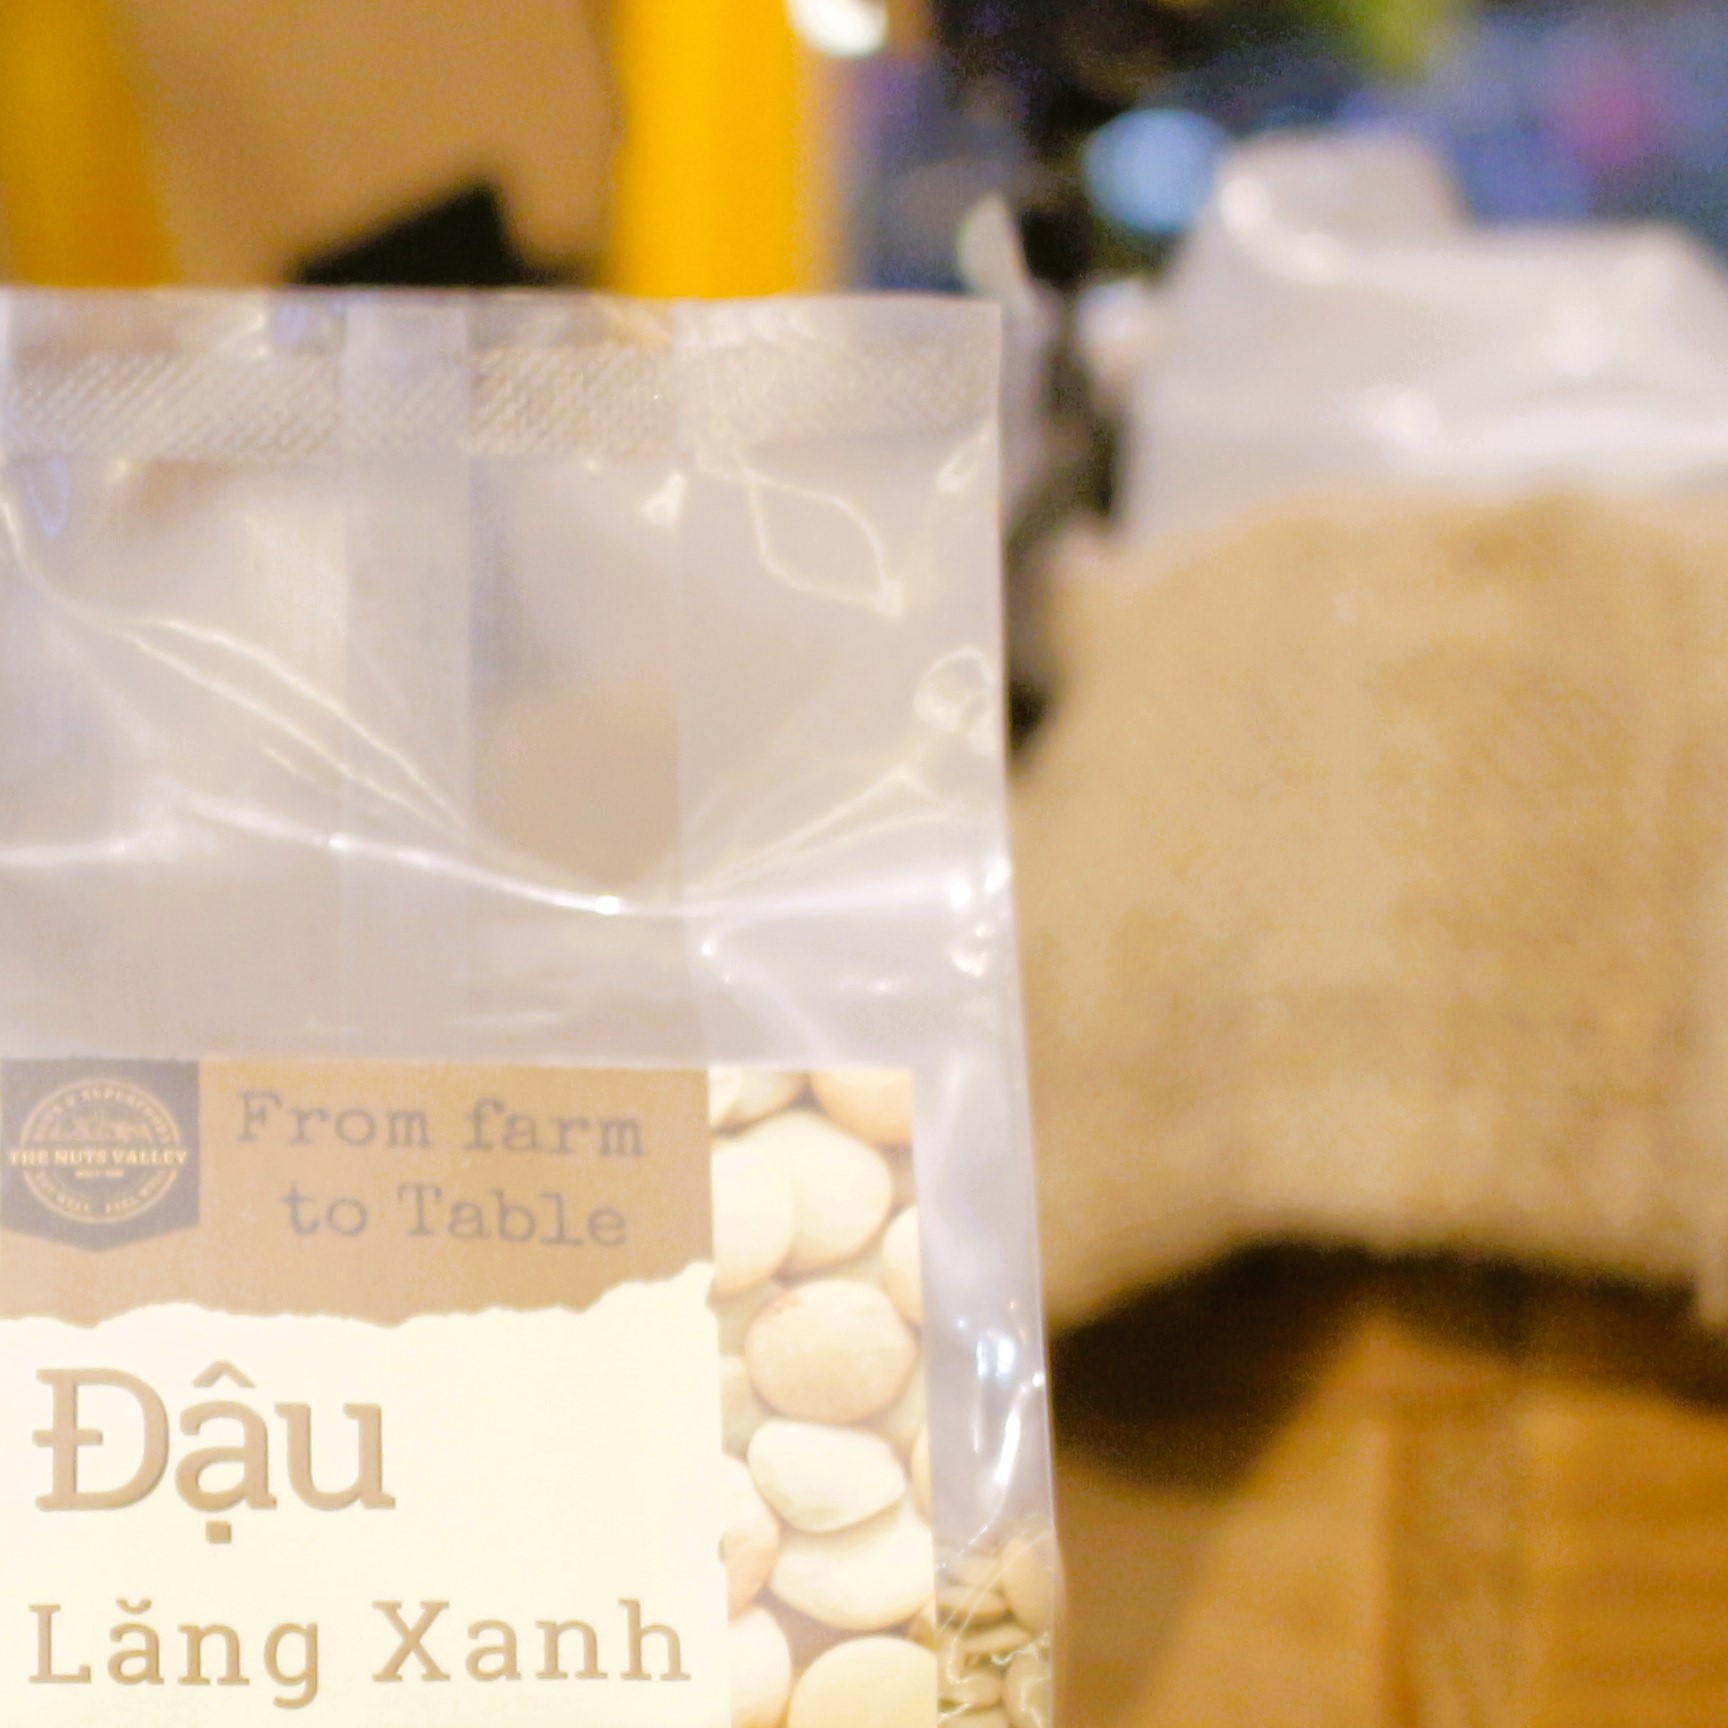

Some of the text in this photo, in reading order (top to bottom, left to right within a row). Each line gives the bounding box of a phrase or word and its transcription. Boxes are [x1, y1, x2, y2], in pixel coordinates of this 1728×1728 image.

[9, 1149, 188, 1167] THE NUTS VALLEY
[236, 1090, 647, 1160] From farm
[280, 1182, 626, 1248] to Table
[33, 1361, 396, 1544] Đậu
[29, 1599, 691, 1710] Lăng Xanh
